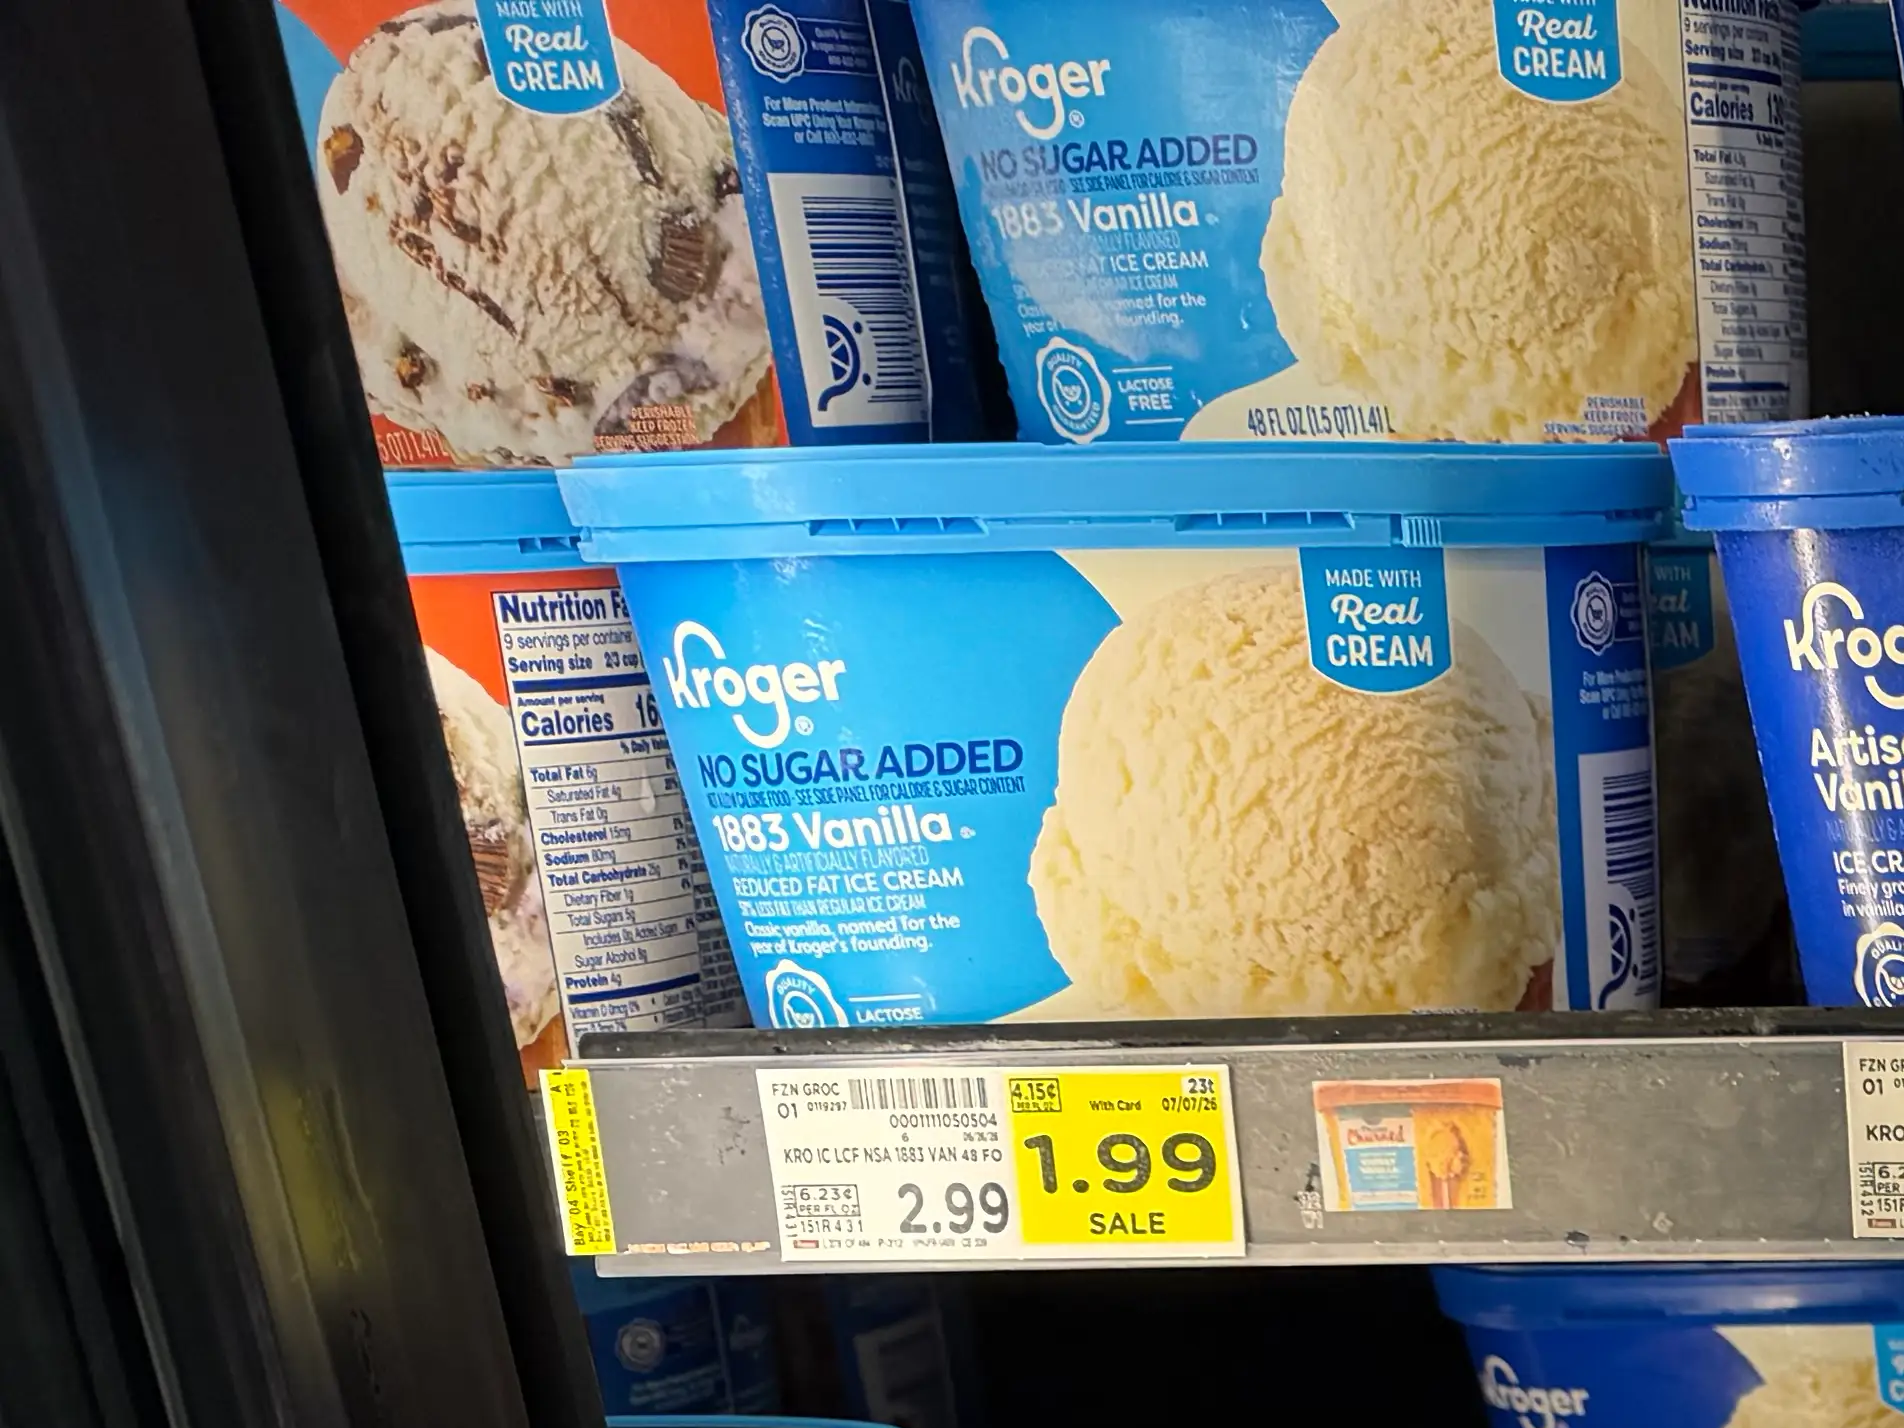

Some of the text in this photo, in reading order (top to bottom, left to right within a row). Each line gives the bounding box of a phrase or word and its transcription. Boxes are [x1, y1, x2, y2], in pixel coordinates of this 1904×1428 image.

[1517, 8, 1597, 42] Real
[952, 25, 1111, 139] Kroger
[1118, 378, 1174, 394] LACTOSE
[1128, 393, 1173, 412] FREE
[1325, 567, 1422, 590] MADE WITH
[500, 594, 607, 624] Nutrition
[1332, 597, 1424, 628] Real
[1327, 633, 1434, 671] CREAM
[663, 620, 846, 748] Kroger
[521, 711, 614, 737] Calories
[699, 738, 1023, 789] NO SUGAR ADDED
[712, 803, 953, 854] 1883 Vanilla
[1832, 850, 1876, 874] ICE
[1837, 878, 1879, 900] Finely
[1841, 899, 1853, 917] in
[1860, 1059, 1887, 1073] FZN
[784, 1147, 958, 1165] KRO IC LCF NSA 1883 VAN
[1025, 1133, 1217, 1194] 1.99
[898, 1182, 1010, 1235] 2.99
[1090, 1213, 1165, 1235] SALE
